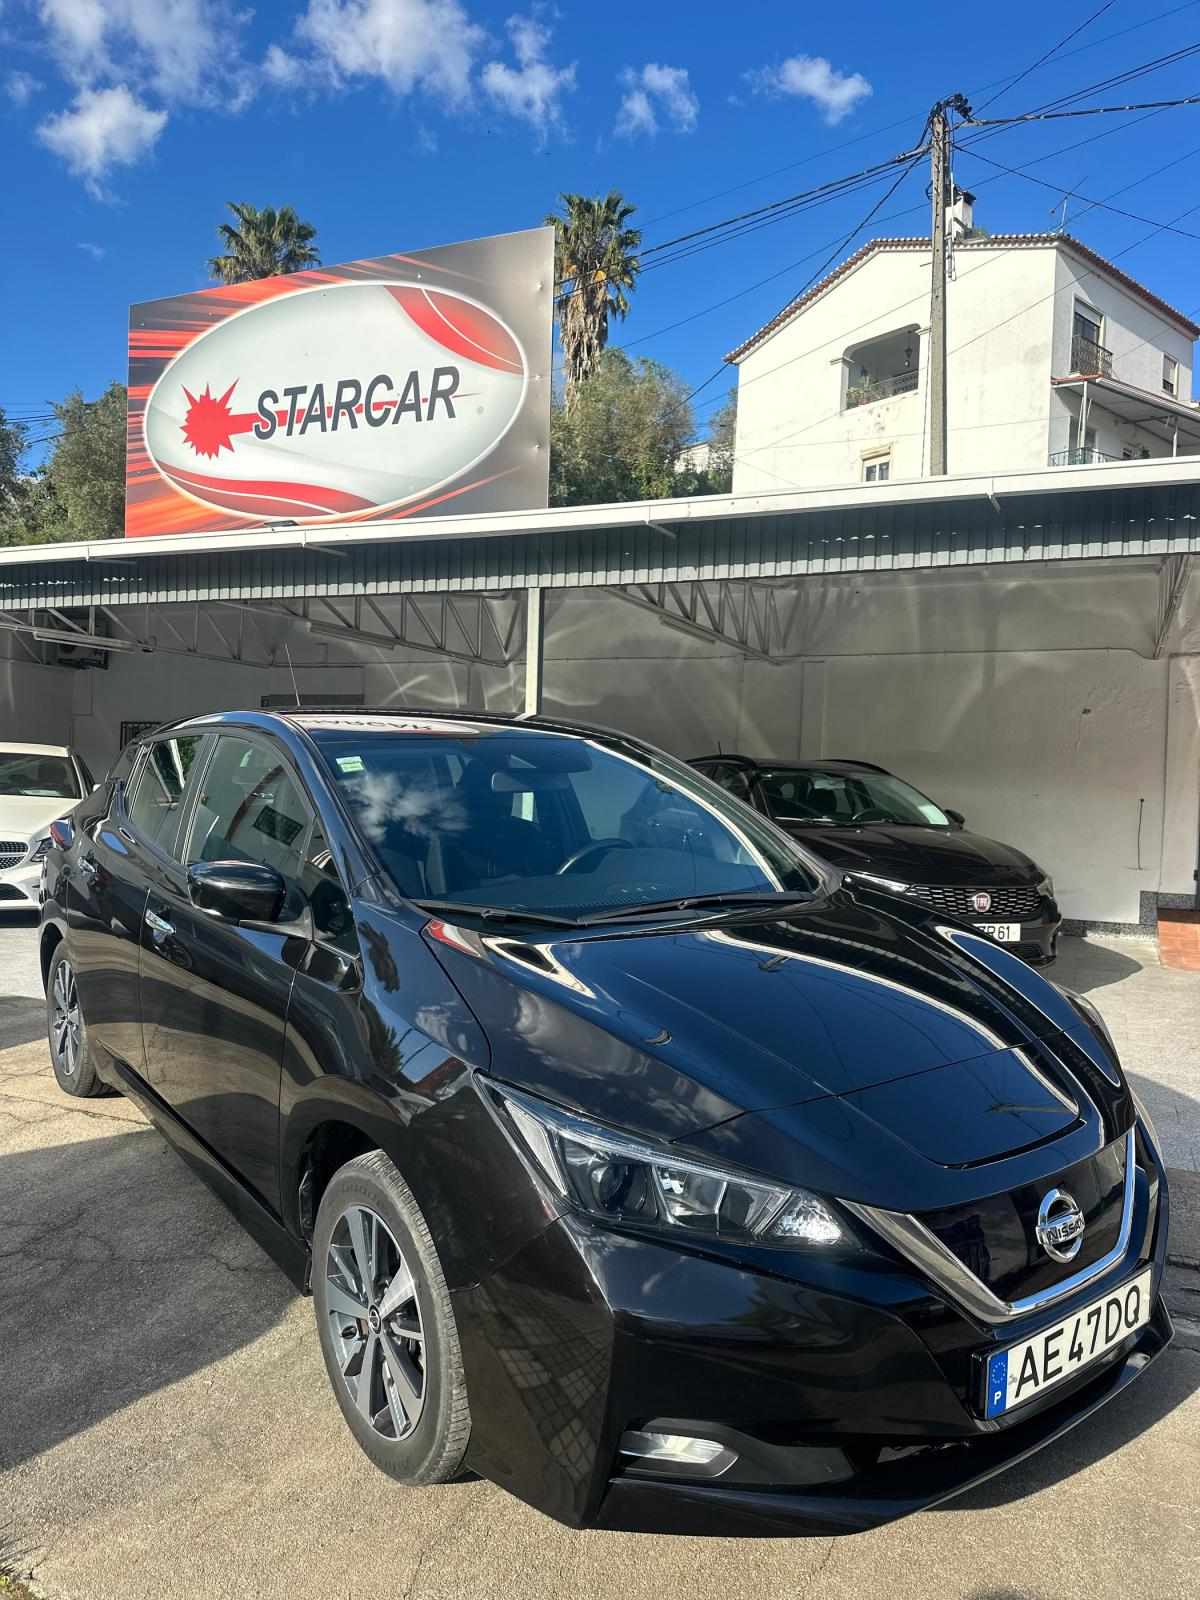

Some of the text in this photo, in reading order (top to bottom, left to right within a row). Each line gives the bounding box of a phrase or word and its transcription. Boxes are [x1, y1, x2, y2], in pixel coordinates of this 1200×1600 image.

[253, 365, 460, 440] STARCAR
[1014, 1285, 1140, 1398] AE47DQ
[994, 1391, 1002, 1405] P
